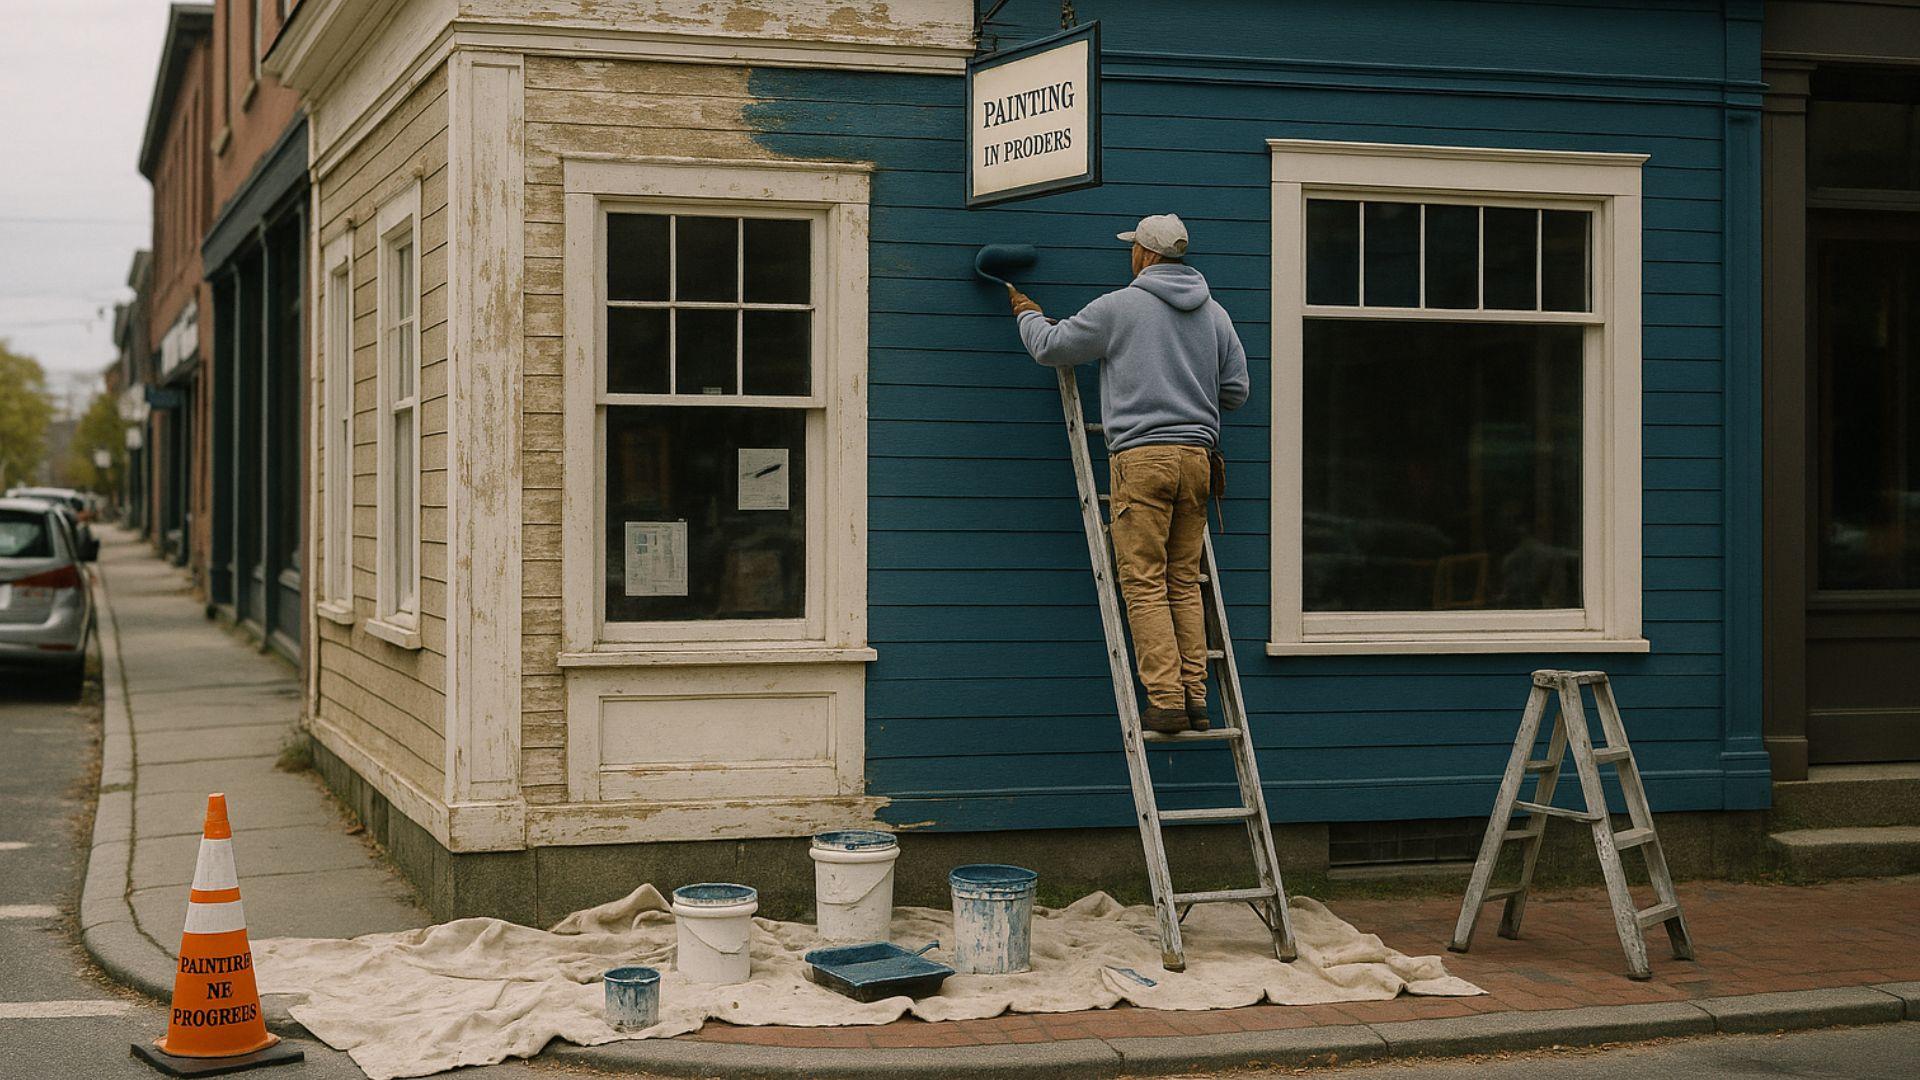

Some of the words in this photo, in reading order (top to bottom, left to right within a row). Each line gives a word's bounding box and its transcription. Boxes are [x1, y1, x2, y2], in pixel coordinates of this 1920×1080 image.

[983, 81, 1075, 129] PAINTING
[983, 143, 1000, 167] IN
[1003, 128, 1072, 163] PRODERS
[206, 981, 234, 1000] NE
